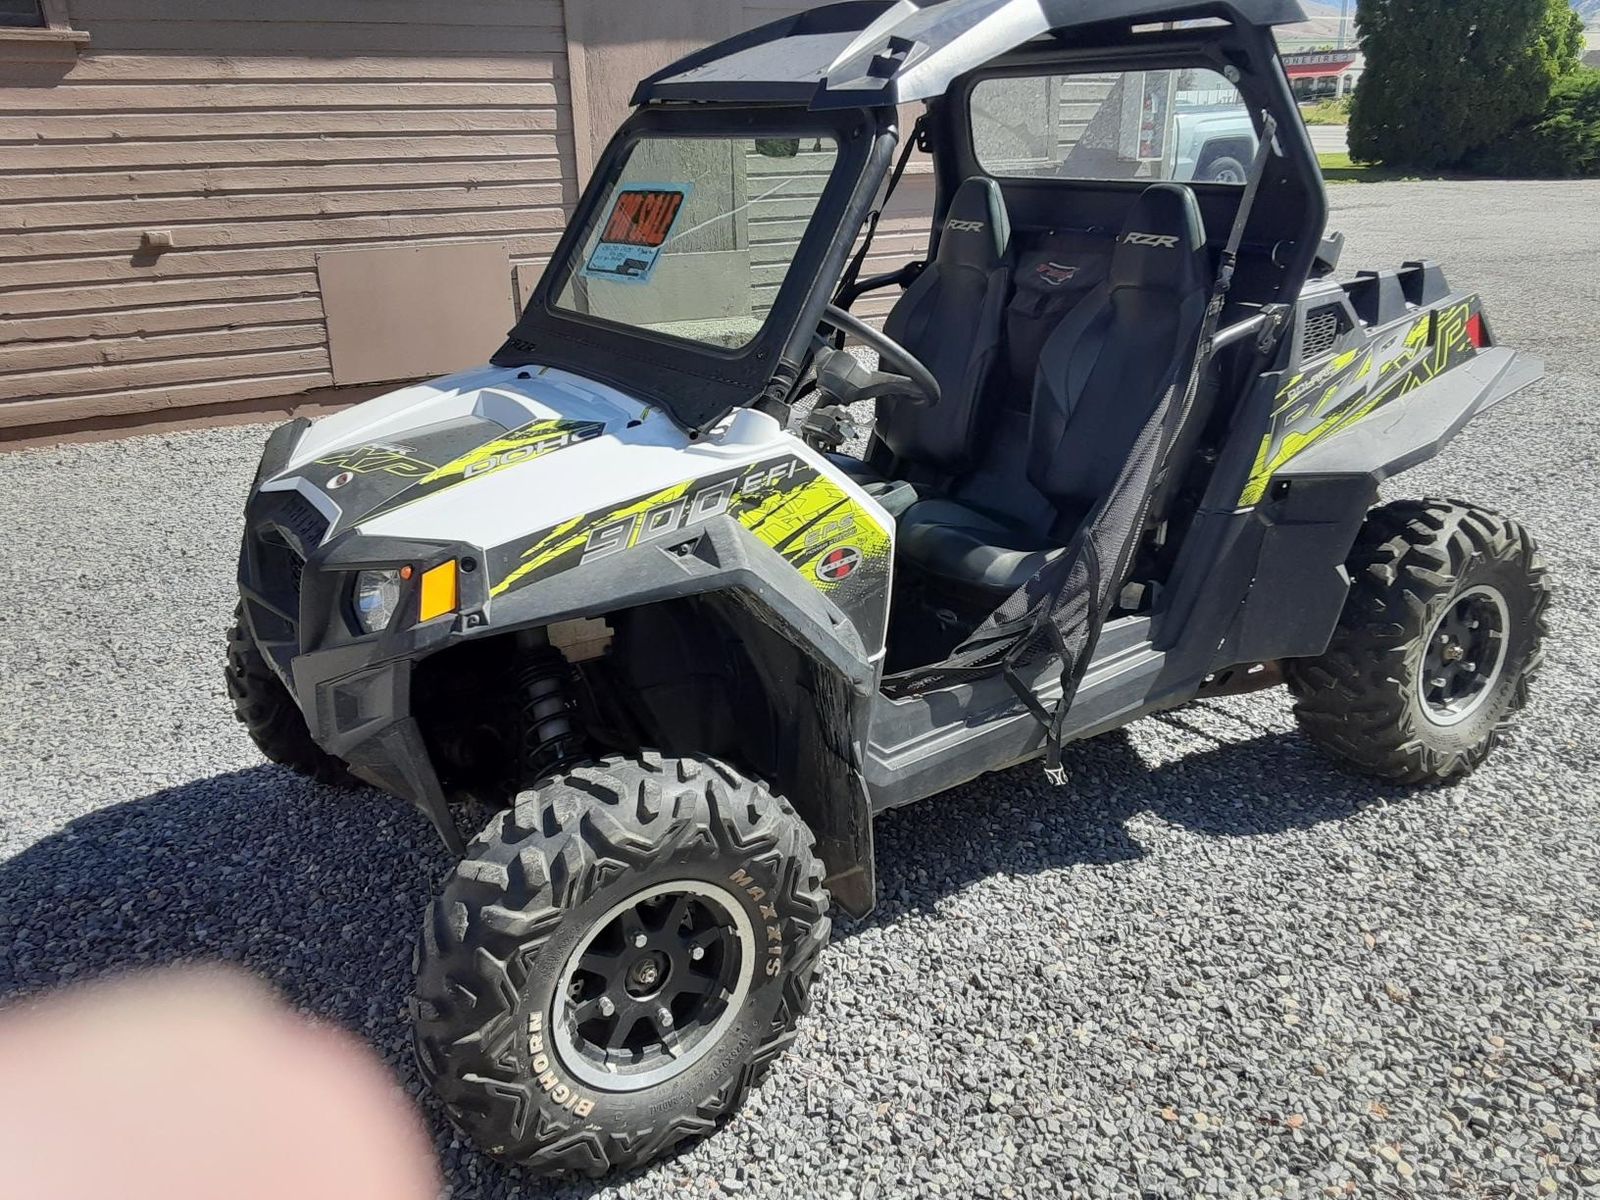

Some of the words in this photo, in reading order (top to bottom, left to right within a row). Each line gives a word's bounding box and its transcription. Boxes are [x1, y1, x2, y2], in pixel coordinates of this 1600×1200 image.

[947, 218, 984, 233] RZR
[1123, 231, 1180, 248] RZR
[315, 446, 440, 477] XP
[463, 423, 604, 479] DOHC
[579, 476, 739, 566] 900
[742, 459, 799, 495] EFI
[804, 515, 855, 546] EPS
[728, 868, 782, 978] MAXXIS
[528, 1012, 595, 1119] BIGHORN
